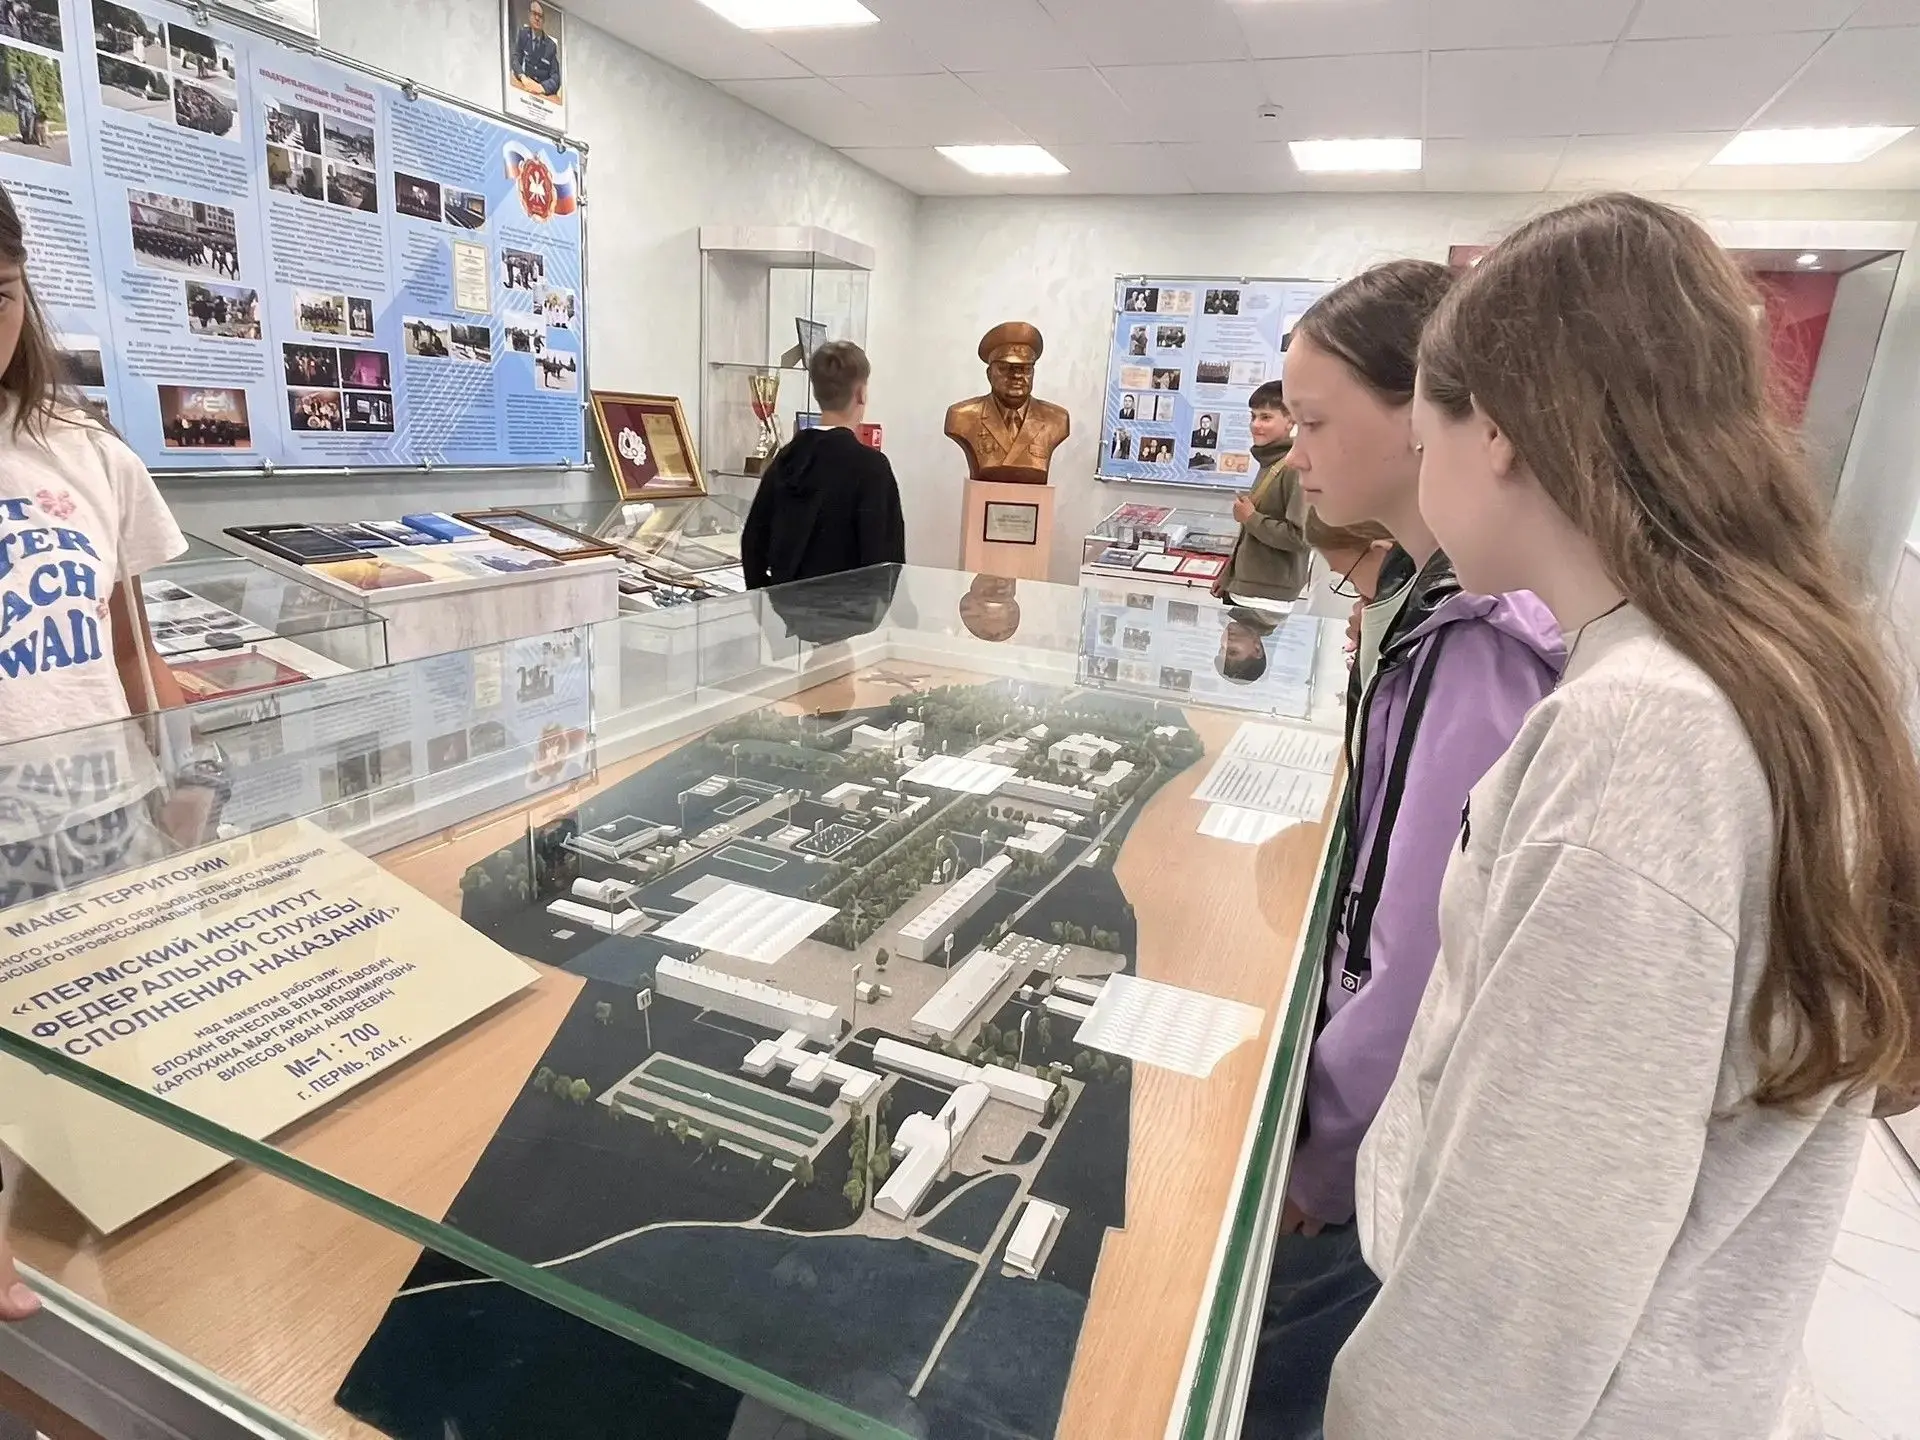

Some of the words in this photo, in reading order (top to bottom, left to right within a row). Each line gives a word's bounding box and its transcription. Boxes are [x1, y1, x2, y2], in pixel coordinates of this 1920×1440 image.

[0, 947, 42, 969] НОГО
[43, 917, 128, 951] КАЗЕННОГО
[128, 871, 256, 921] ОБРАЗОВАТЕЛЬНОГО
[257, 847, 327, 879] УЧРЕЖДЕНИЯ
[5, 902, 88, 938] МАКЕТ
[88, 857, 229, 908] ТЕРРИТОРИИ
[65, 896, 219, 957] ПРОФЕССИОНАЛЬНОГО
[220, 867, 301, 901] ОБРАЗОВАНИЯ
[11, 936, 199, 1016] «ПЕРМСКИЙ
[196, 888, 323, 945] ИНСТИТУТ
[31, 938, 258, 1038] ФЕДЕРАЛЬНОЙ
[256, 897, 363, 946] СЛУЖБЫ
[53, 968, 252, 1055] СПОЛНЕНИЯ
[249, 906, 400, 976] НАКАЗАНИЙ»
[193, 1022, 225, 1039] над
[223, 995, 281, 1025] макетом
[280, 966, 343, 1000] работали:
[152, 1040, 218, 1077] БЛОХИН
[215, 1006, 291, 1046] ВЯЧЕСЛАВ
[289, 956, 395, 1010] ВЛАДИСЛАВОВИЧ
[152, 1046, 245, 1095] КАРПУХИНА
[241, 1007, 323, 1052] МАРГАРИТА
[320, 961, 417, 1012] ВЛАДИМИРОВНА
[217, 1042, 288, 1082] ВИЛЕСОВ
[286, 1023, 325, 1048] ИВАН
[324, 987, 396, 1028] АНДРЕЕВИЧ
[297, 1091, 312, 1101] г.
[308, 1060, 371, 1093] ПЕРМЬ,
[365, 1038, 399, 1061] 2014
[398, 1035, 412, 1044] г.
[340, 1022, 380, 1048] 700
